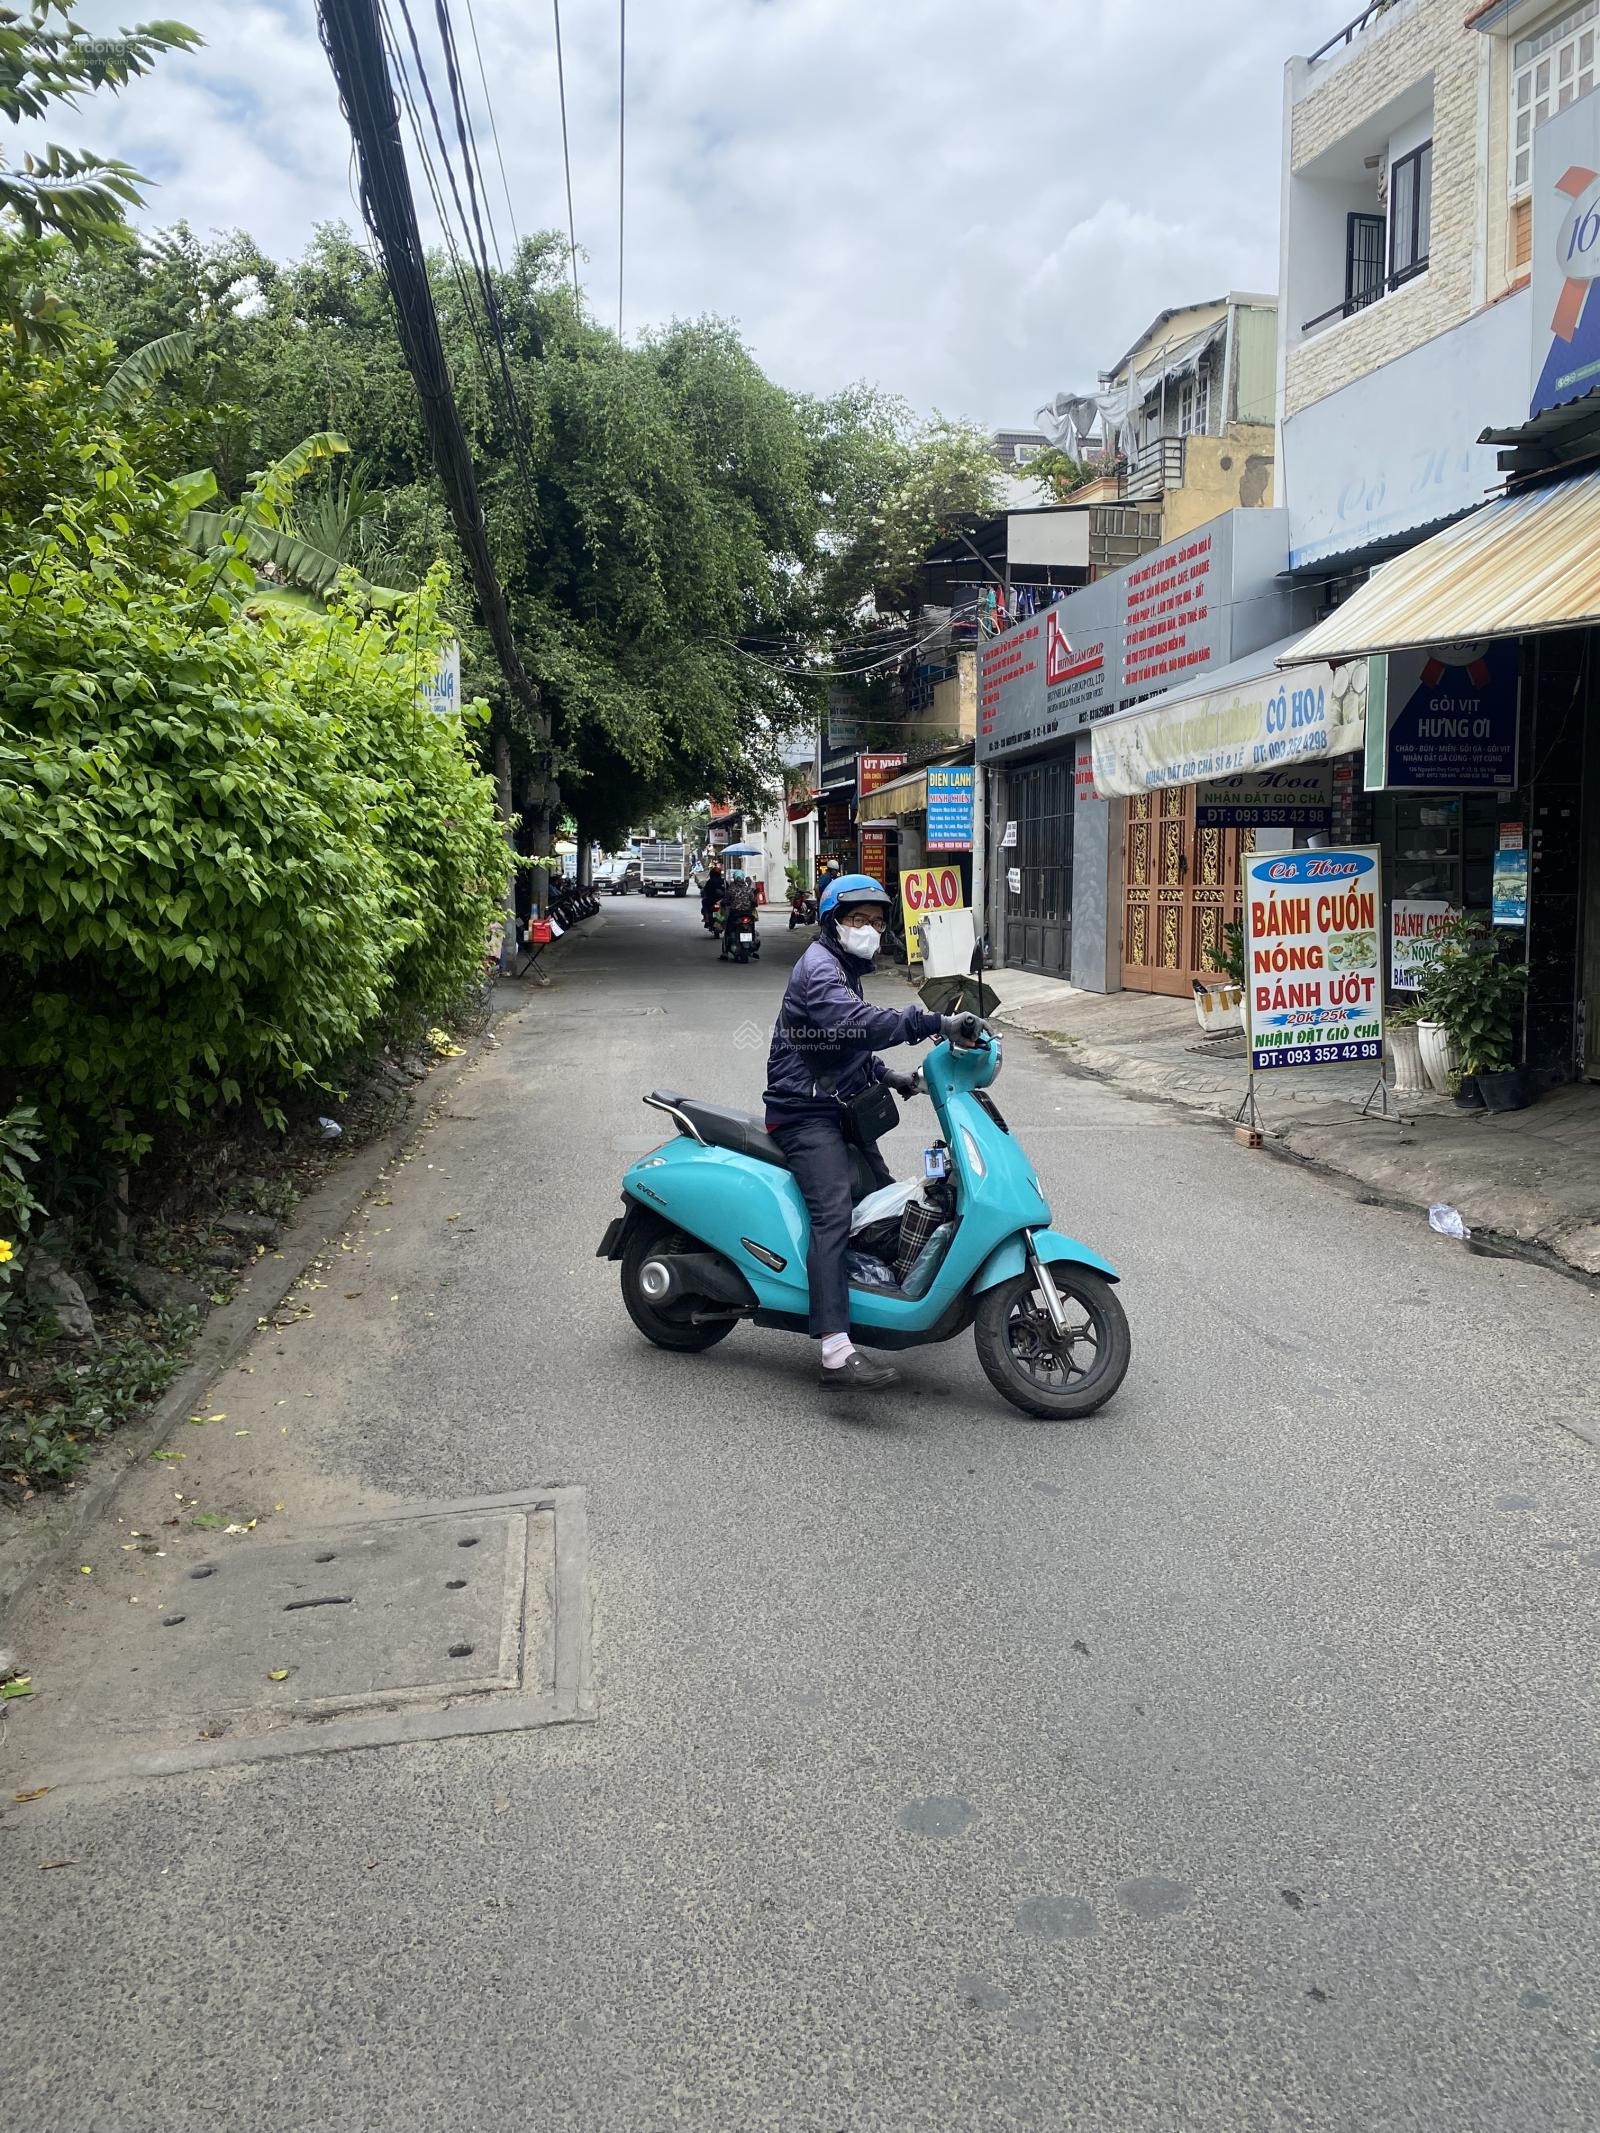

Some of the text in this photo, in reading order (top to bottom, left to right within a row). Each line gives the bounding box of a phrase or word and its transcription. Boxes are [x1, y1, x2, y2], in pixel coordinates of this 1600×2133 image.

[1266, 685, 1288, 734] CÔ
[1291, 685, 1325, 729] HOA
[1459, 698, 1480, 714] VỊT
[1418, 717, 1490, 738] HƯNG ƠI
[864, 757, 877, 770] ÚT
[1182, 758, 1196, 778] GIÒ
[1226, 756, 1232, 769] &
[1269, 739, 1287, 761] 093
[929, 771, 971, 790] ĐIỆN LẠNH
[1257, 771, 1321, 789] Hoa
[930, 794, 948, 803] MINH
[1204, 790, 1326, 805] NHẬN ĐẶT GIÒ CHẢ
[1207, 809, 1325, 822] ĐT: 093 352 42 98
[1269, 859, 1358, 879] Cô Hoa
[1252, 877, 1375, 938] BÁNH CUỐN
[1393, 905, 1424, 937] BÁNH
[1254, 942, 1323, 974] NÓNG
[1256, 971, 1375, 1012] BÁNH ƯỚT
[1287, 1009, 1348, 1024] 20k-25k
[1255, 1020, 1380, 1049] NHẬN ĐẶT GIÒ CHẢ
[1259, 1043, 1377, 1067] ĐT: 093 352 42 98
